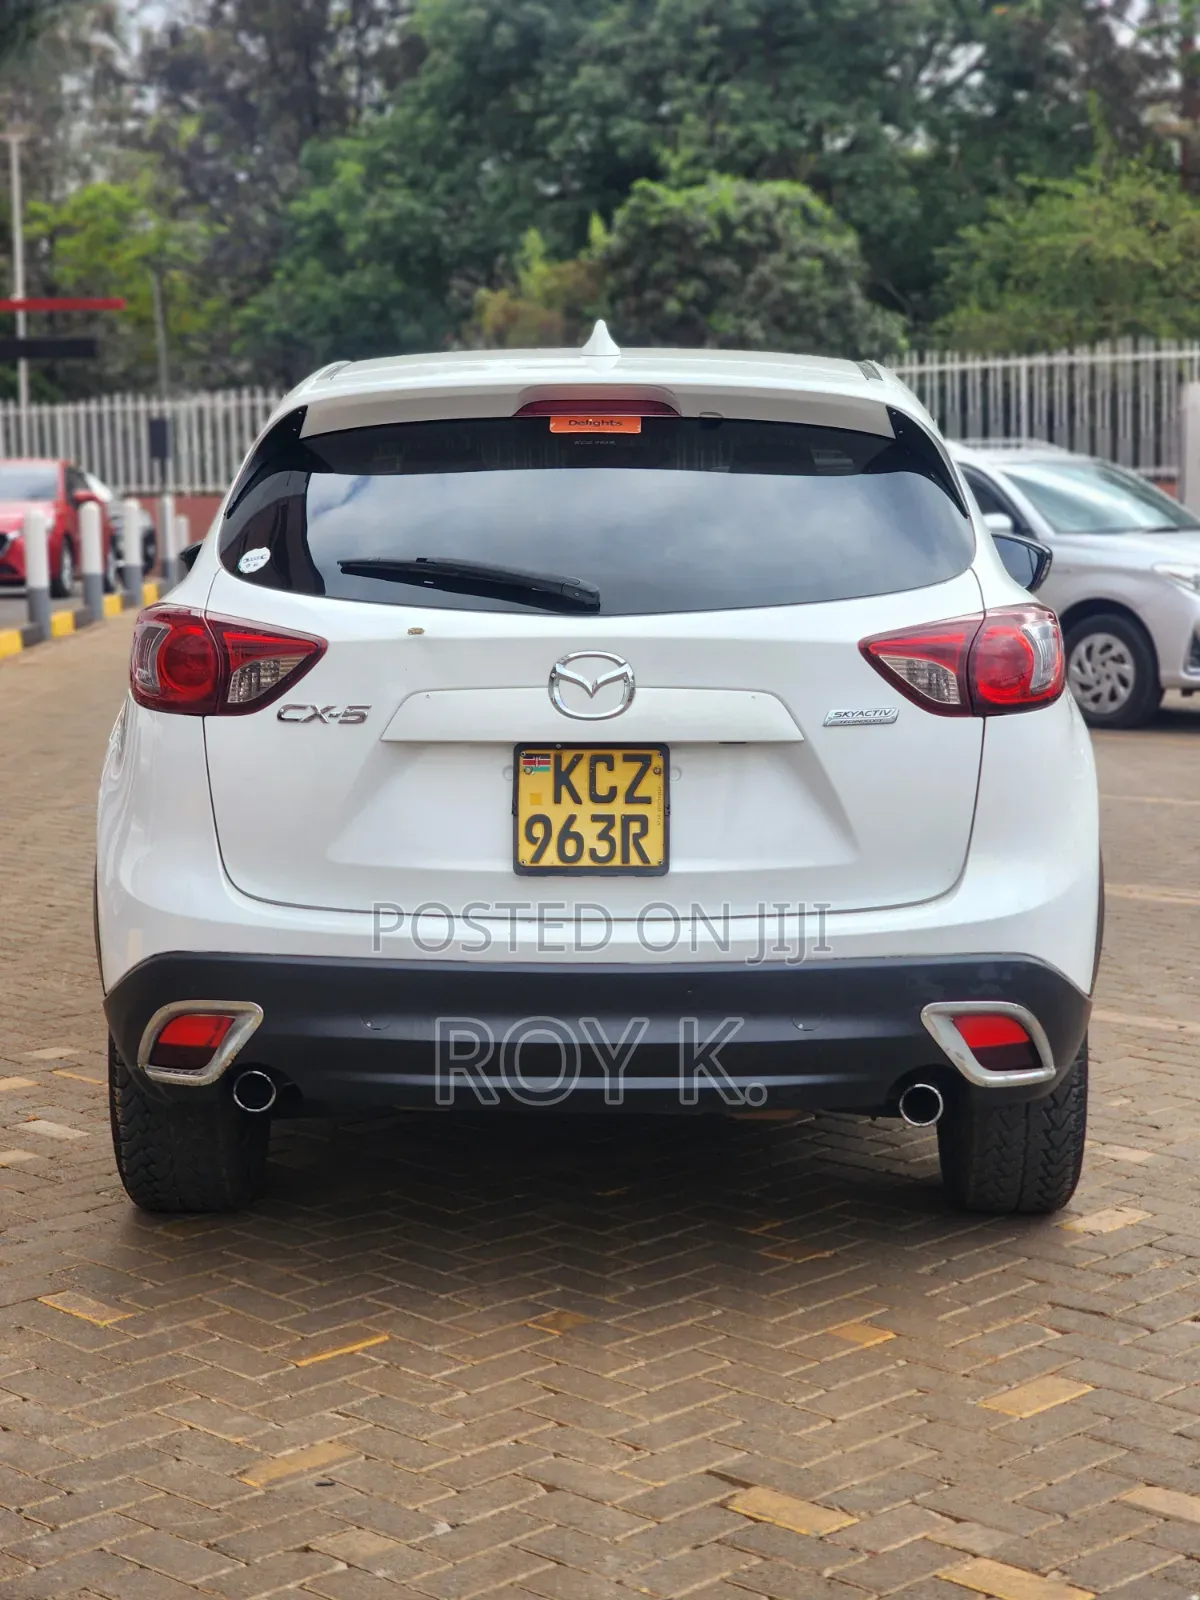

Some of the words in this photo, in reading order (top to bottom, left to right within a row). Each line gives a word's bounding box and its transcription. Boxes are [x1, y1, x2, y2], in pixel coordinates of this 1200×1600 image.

[568, 418, 623, 427] Delights
[276, 703, 373, 724] CX-5
[833, 709, 892, 719] SKYACTIV
[553, 752, 653, 806] KCZ
[524, 813, 652, 865] 963R
